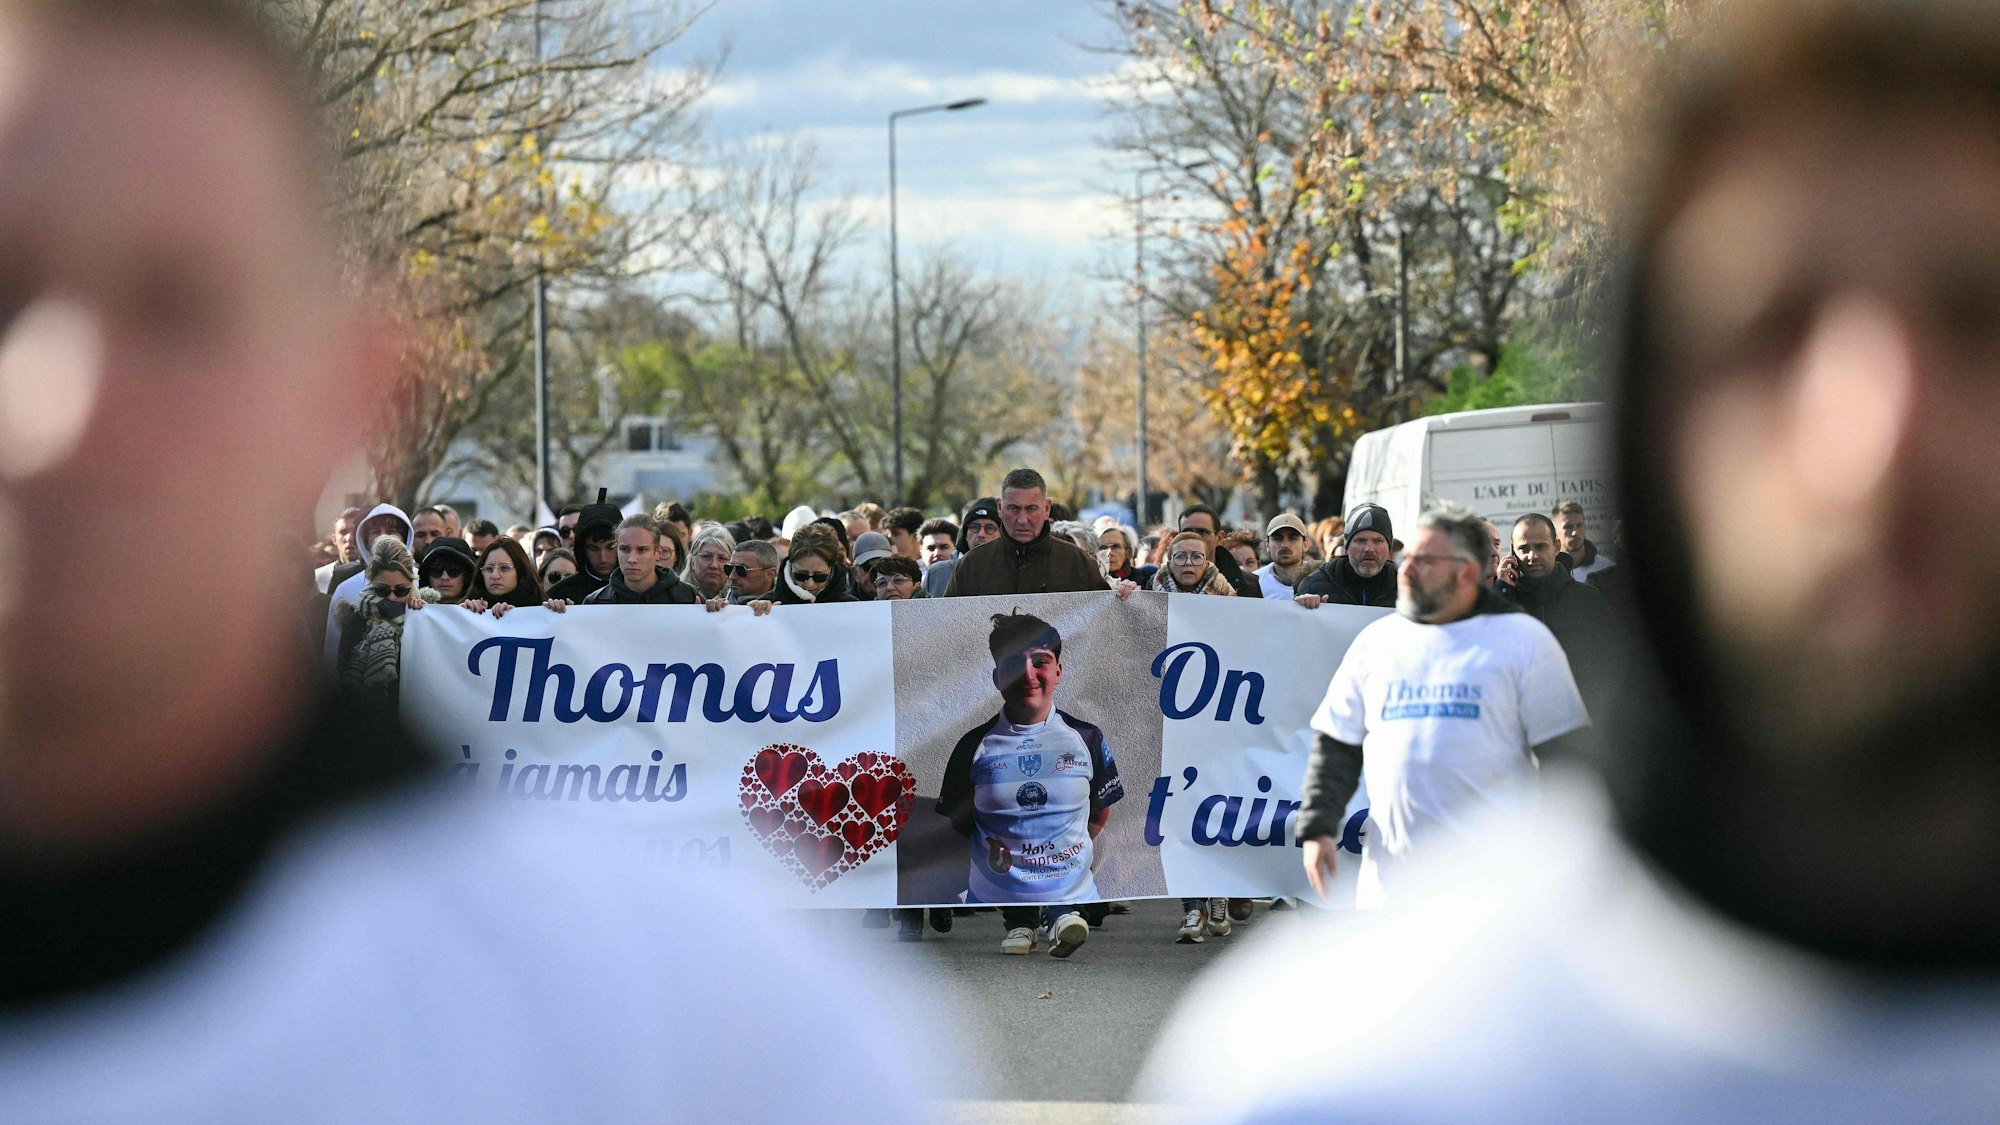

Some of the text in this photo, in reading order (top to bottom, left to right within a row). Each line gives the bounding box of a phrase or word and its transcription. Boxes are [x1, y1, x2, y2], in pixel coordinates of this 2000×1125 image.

[1473, 484, 1519, 499] L'ART
[1528, 483, 1549, 497] DU
[467, 635, 842, 724] Thomas
[1151, 641, 1265, 725] On
[1384, 679, 1482, 702] Thomas
